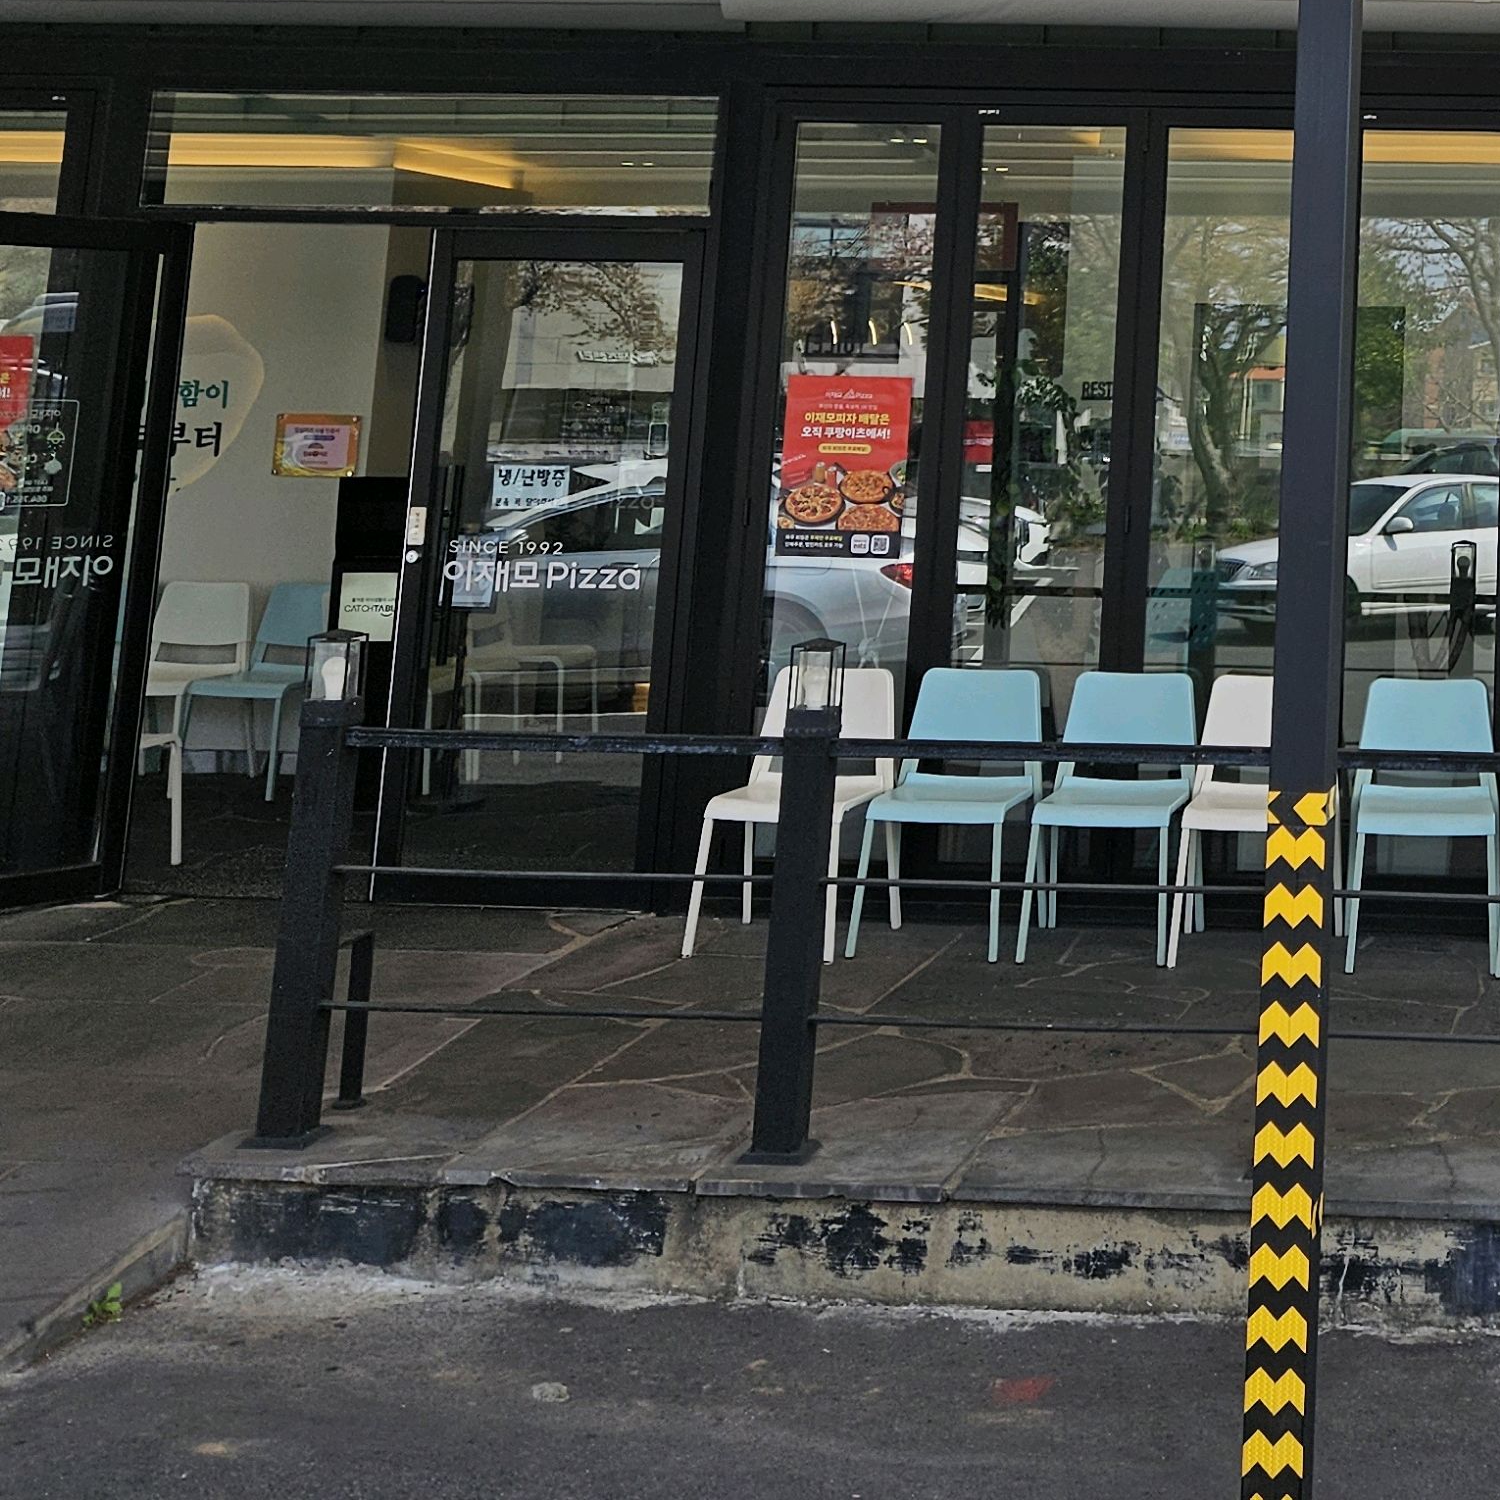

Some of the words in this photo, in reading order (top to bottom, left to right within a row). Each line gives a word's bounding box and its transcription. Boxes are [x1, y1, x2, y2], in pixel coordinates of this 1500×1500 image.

[1081, 381, 1113, 400] REST
[804, 411, 857, 425] 이재모피자
[859, 413, 891, 426] 배달은
[801, 426, 822, 439] 오직
[448, 540, 509, 554] SINCE
[518, 541, 564, 556] 1992
[443, 560, 541, 593] 이재모
[546, 562, 641, 590] Pizza
[344, 604, 395, 613] CATCHTABL
